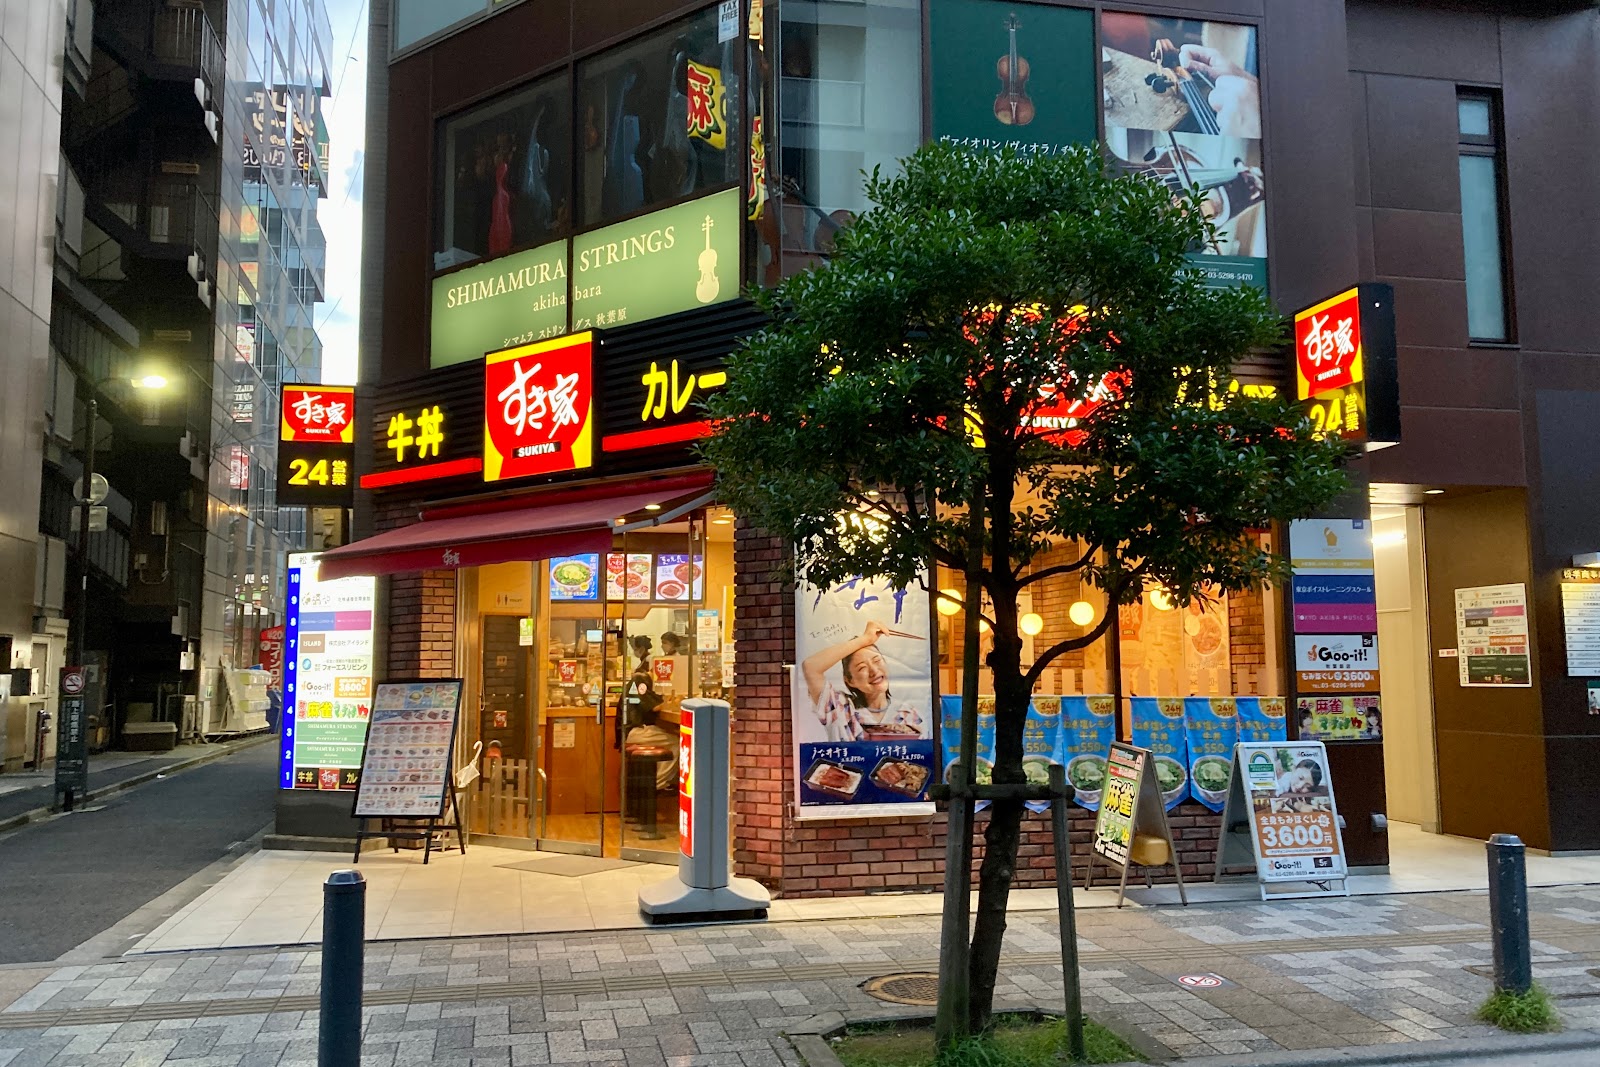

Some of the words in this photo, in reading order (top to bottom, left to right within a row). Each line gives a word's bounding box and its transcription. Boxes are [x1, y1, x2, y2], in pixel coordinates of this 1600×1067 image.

[722, 1, 737, 12] TAX
[721, 9, 738, 22] FREE
[446, 258, 567, 309] SHIMAMURA
[579, 226, 675, 273] STRINGS
[1207, 270, 1254, 281] 03-5298-5470
[503, 331, 534, 348] シマムラ
[595, 307, 627, 327] 秋葉原
[1303, 314, 1355, 367] すき家
[1317, 367, 1342, 382] SUKIYA
[641, 358, 727, 422] カレー
[497, 360, 580, 440] すき家
[291, 391, 347, 429] すき家
[1344, 392, 1360, 432] 営業
[387, 405, 444, 463] 牛丼
[518, 442, 556, 457] SUKIYA
[287, 458, 329, 486] 24
[331, 460, 347, 486] 営業
[290, 573, 299, 583] 10
[291, 595, 297, 605] 9
[290, 617, 296, 626] 8
[289, 639, 296, 648] 7
[1363, 638, 1372, 646] 5F
[1318, 646, 1368, 662] Goo-it!
[288, 661, 295, 671] 6
[287, 683, 294, 693] 5
[286, 705, 293, 715] 4
[307, 701, 333, 718] 麻雀
[1041, 702, 1058, 710] 24H
[1094, 702, 1112, 710] 24H
[1165, 704, 1182, 713] 24H
[1217, 704, 1233, 712] 24H
[1266, 704, 1283, 712] 24H
[1316, 698, 1344, 715] 麻雀
[286, 727, 292, 737] 3
[1024, 730, 1044, 740] 牛丼
[1079, 730, 1098, 740] 牛丼
[285, 750, 291, 759] 2
[285, 771, 290, 780] 1
[297, 771, 314, 783] 牛丼
[1104, 777, 1136, 819] 麻雀
[1260, 814, 1317, 826] 全身もみほぐし
[1318, 858, 1328, 867] 5F
